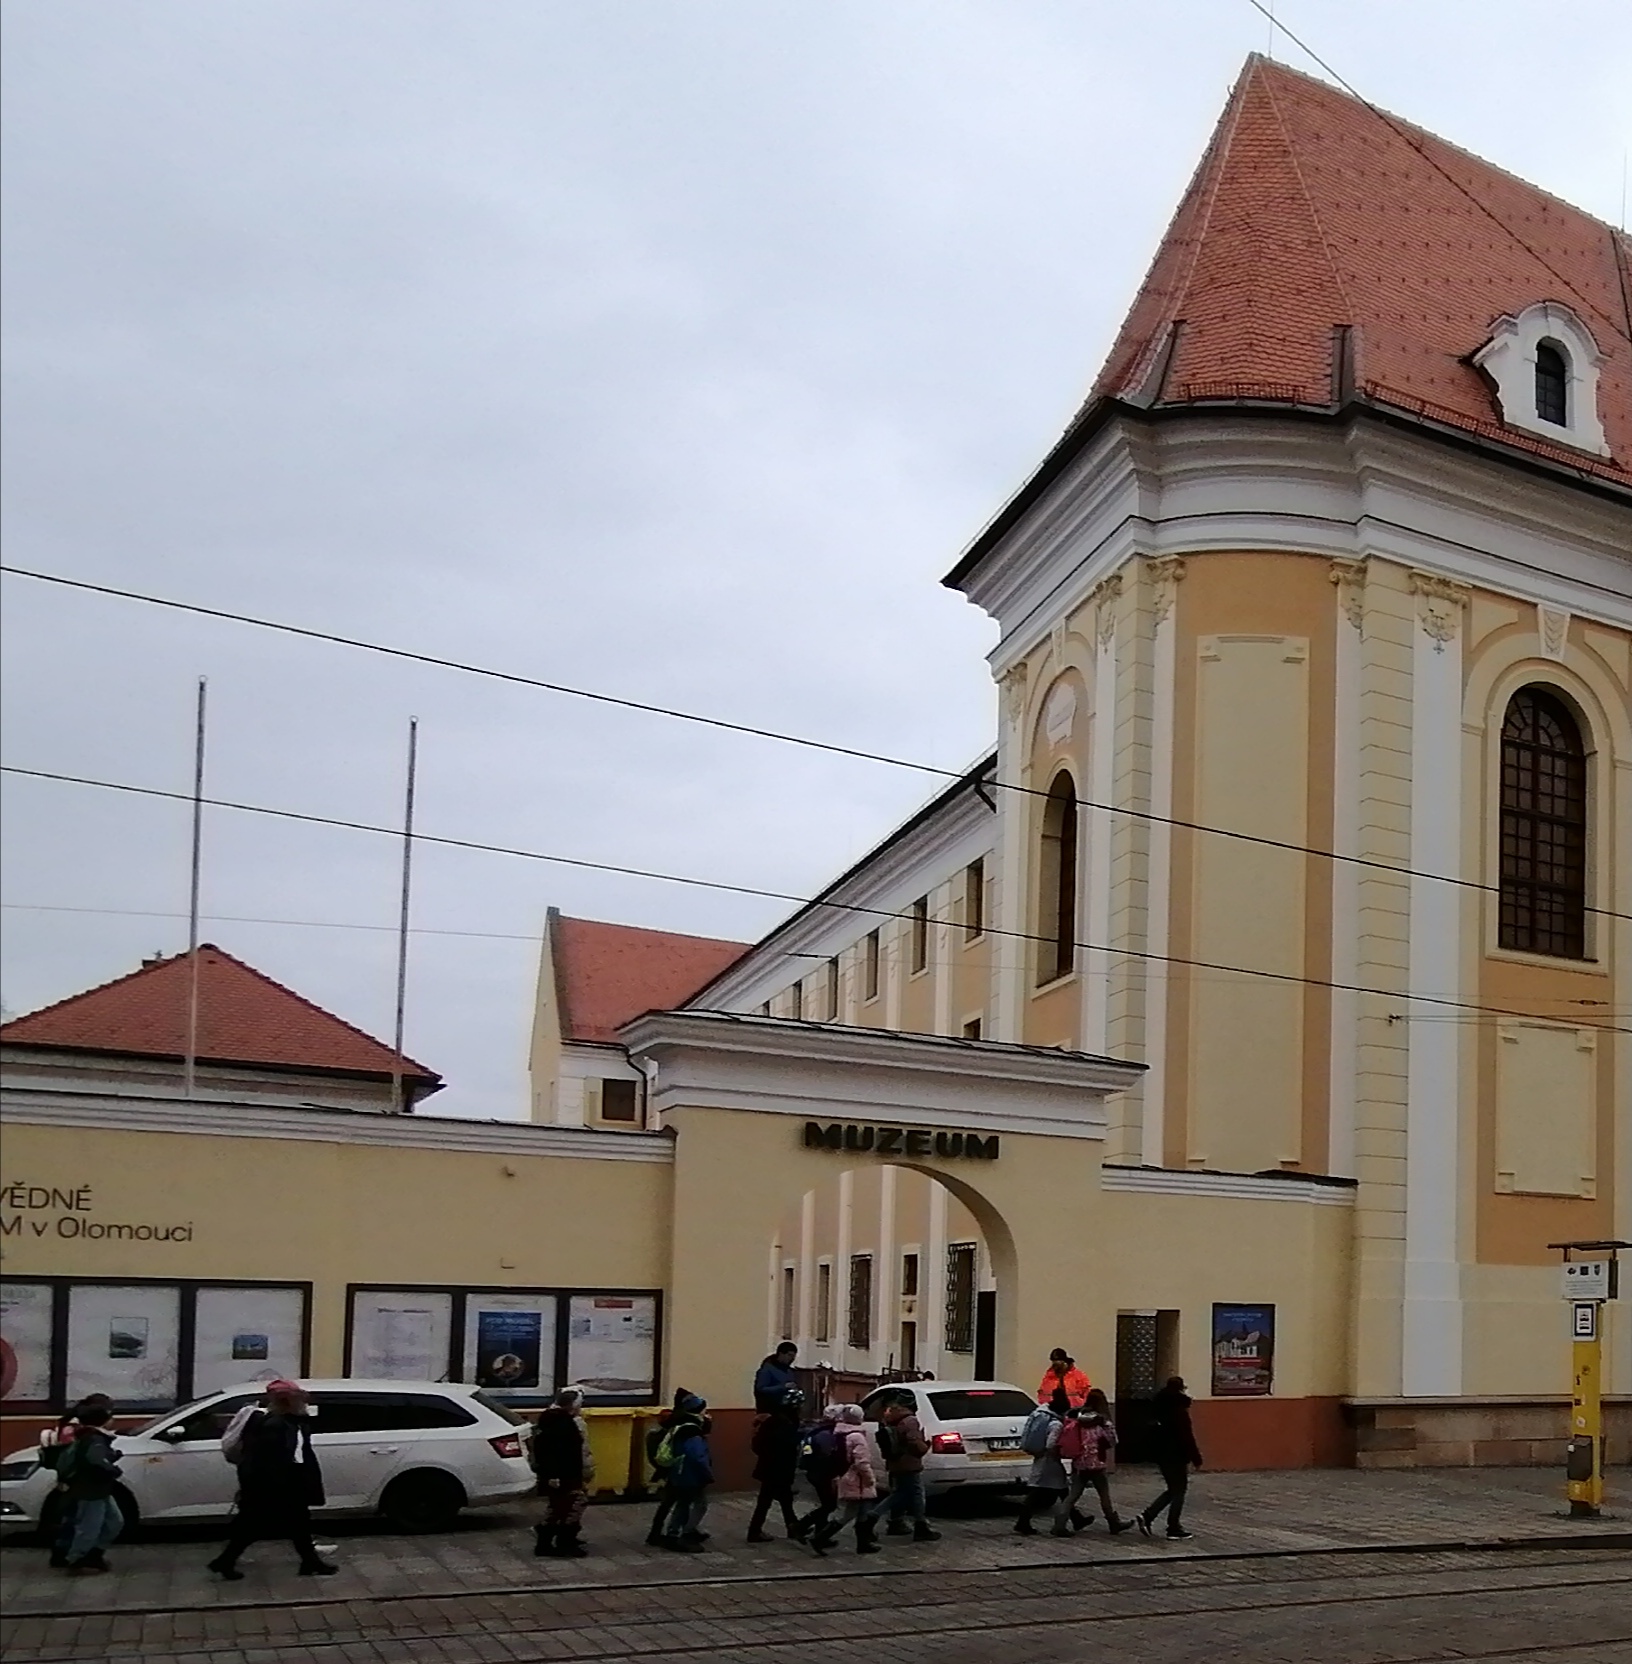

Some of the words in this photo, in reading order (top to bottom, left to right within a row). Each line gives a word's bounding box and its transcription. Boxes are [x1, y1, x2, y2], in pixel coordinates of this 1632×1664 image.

[805, 1121, 999, 1160] MUZEUM
[32, 1221, 48, 1237] v
[57, 1217, 193, 1242] Olomouci
